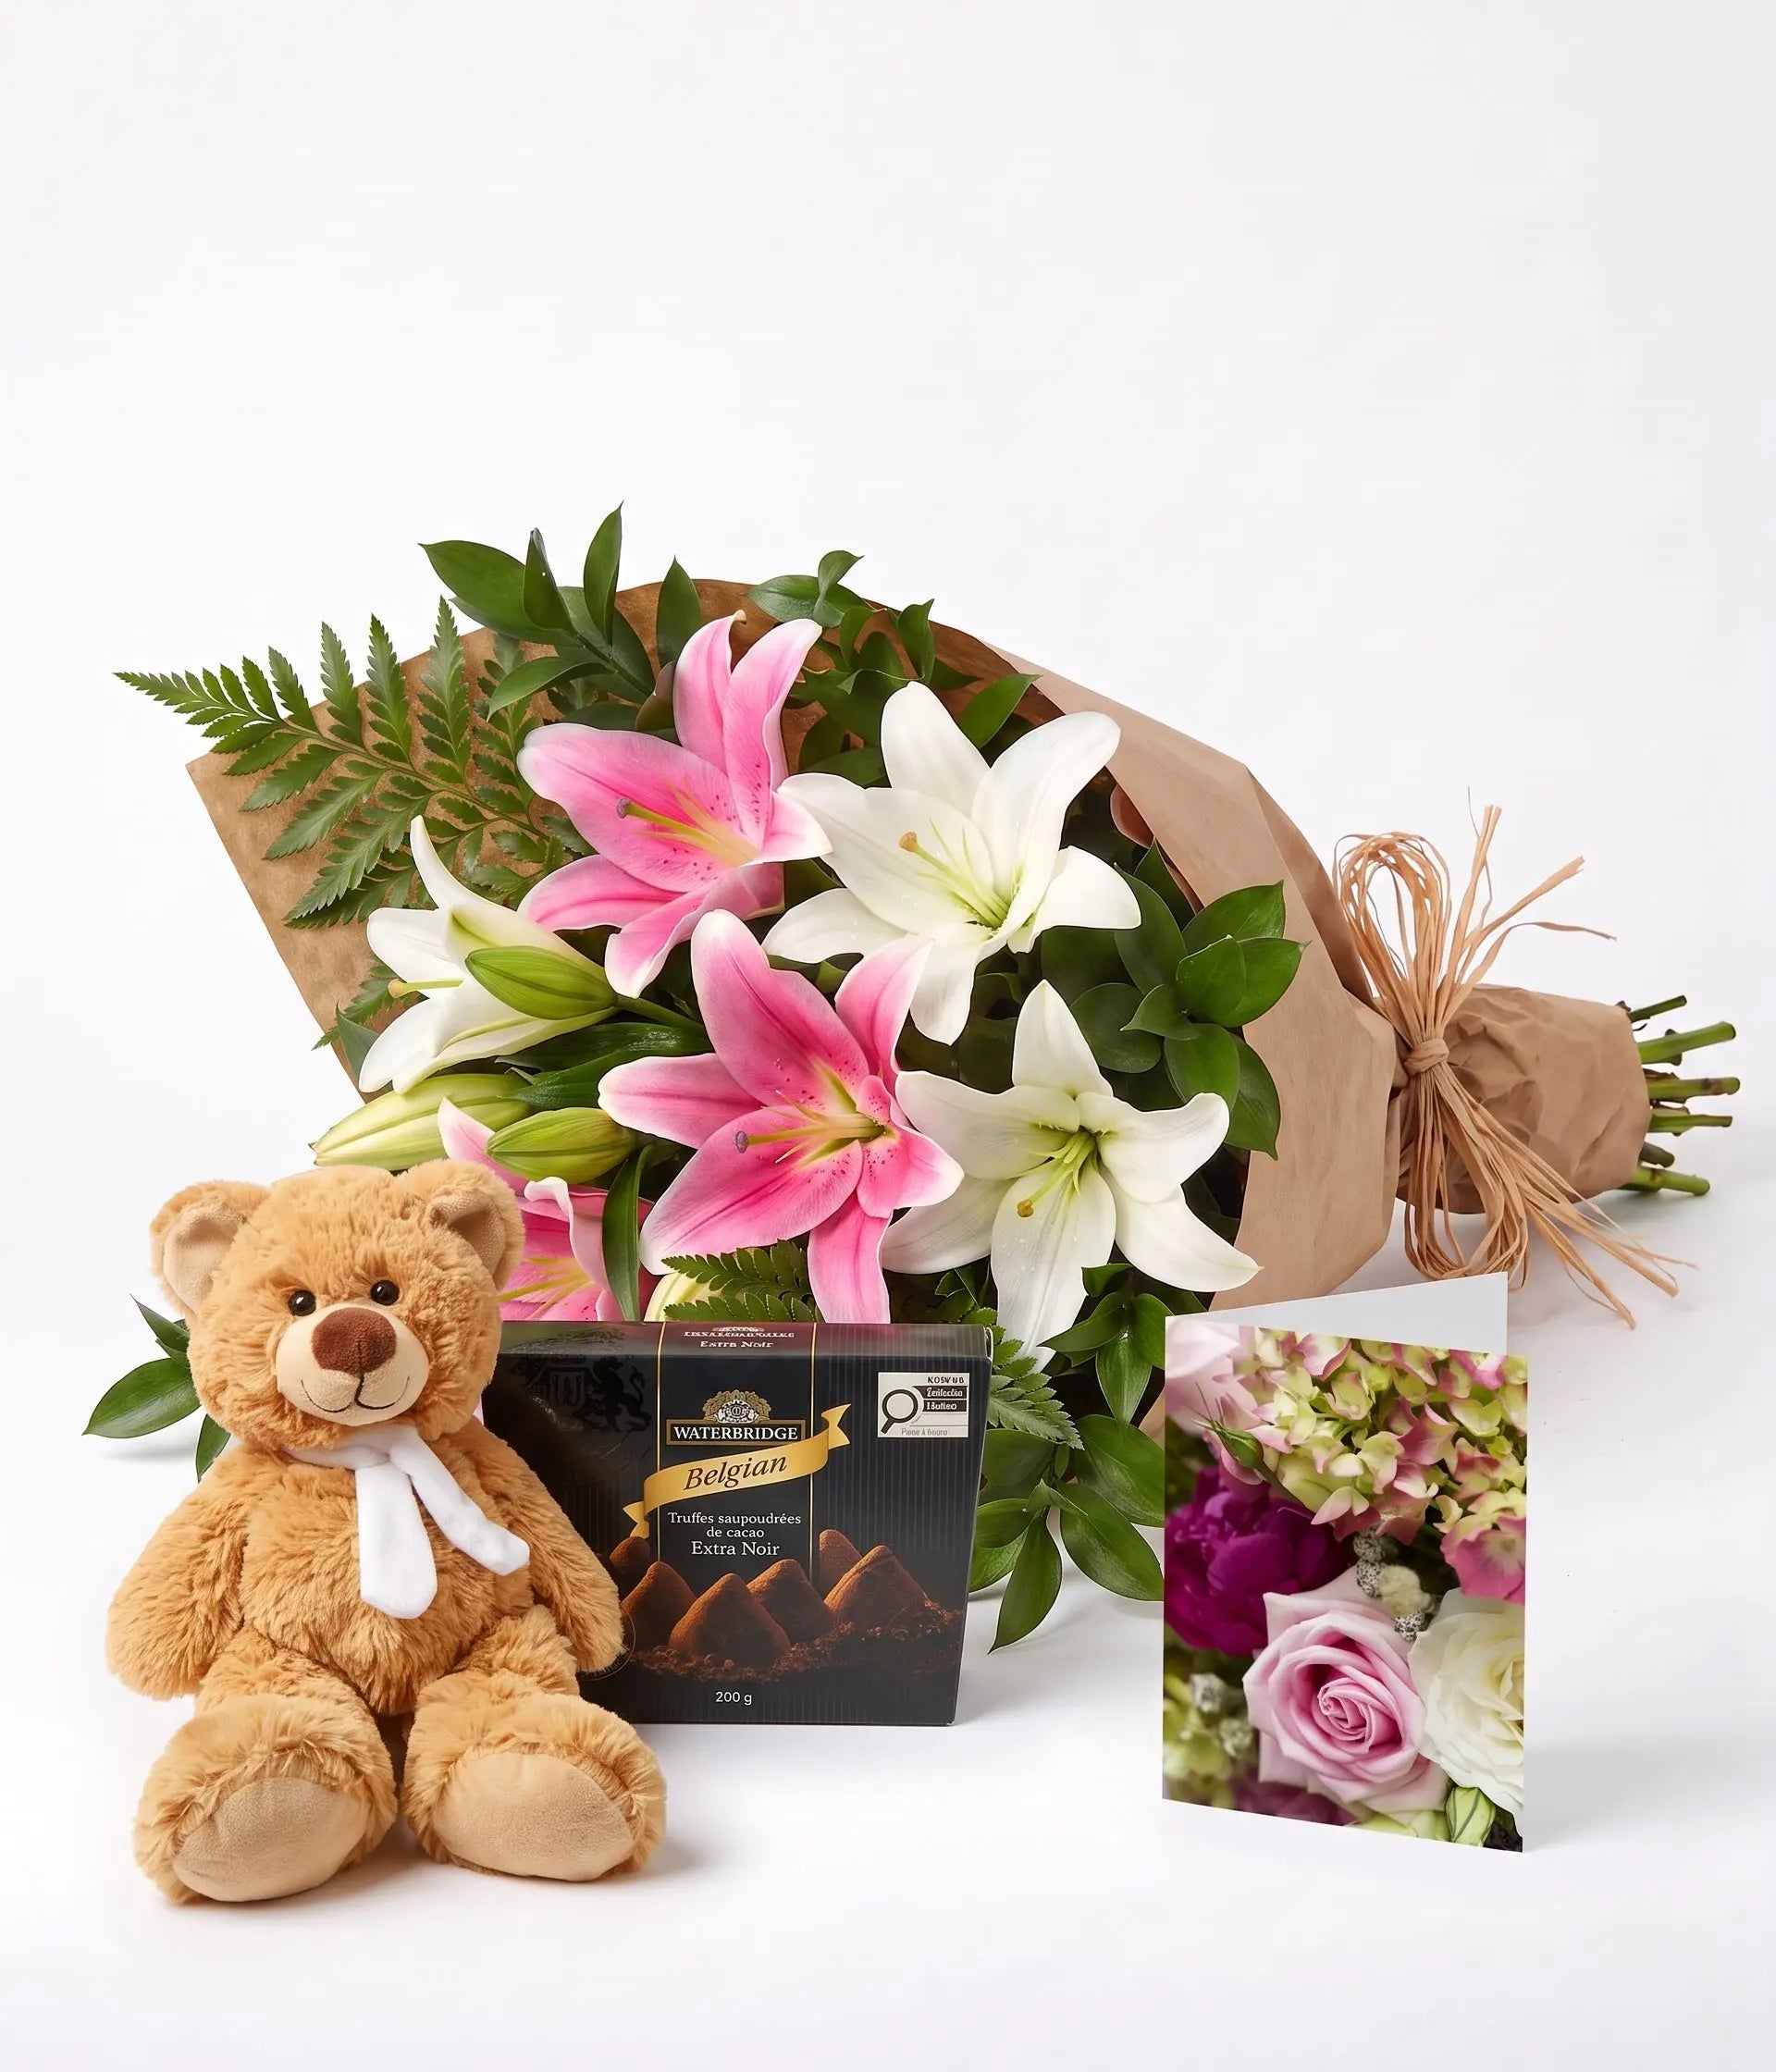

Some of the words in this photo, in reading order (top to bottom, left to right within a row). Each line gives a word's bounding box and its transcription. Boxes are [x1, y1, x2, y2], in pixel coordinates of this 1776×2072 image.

[673, 1426, 798, 1440] WATERBRIDGE
[683, 1456, 787, 1490] Belgian
[667, 1511, 714, 1524] Truffes
[718, 1512, 802, 1526] saupoudrées
[706, 1526, 722, 1537] de
[726, 1528, 765, 1537] cacao
[691, 1540, 736, 1555] Extra
[741, 1541, 780, 1556] Noir
[715, 1691, 740, 1703] 200
[744, 1693, 752, 1706] g
